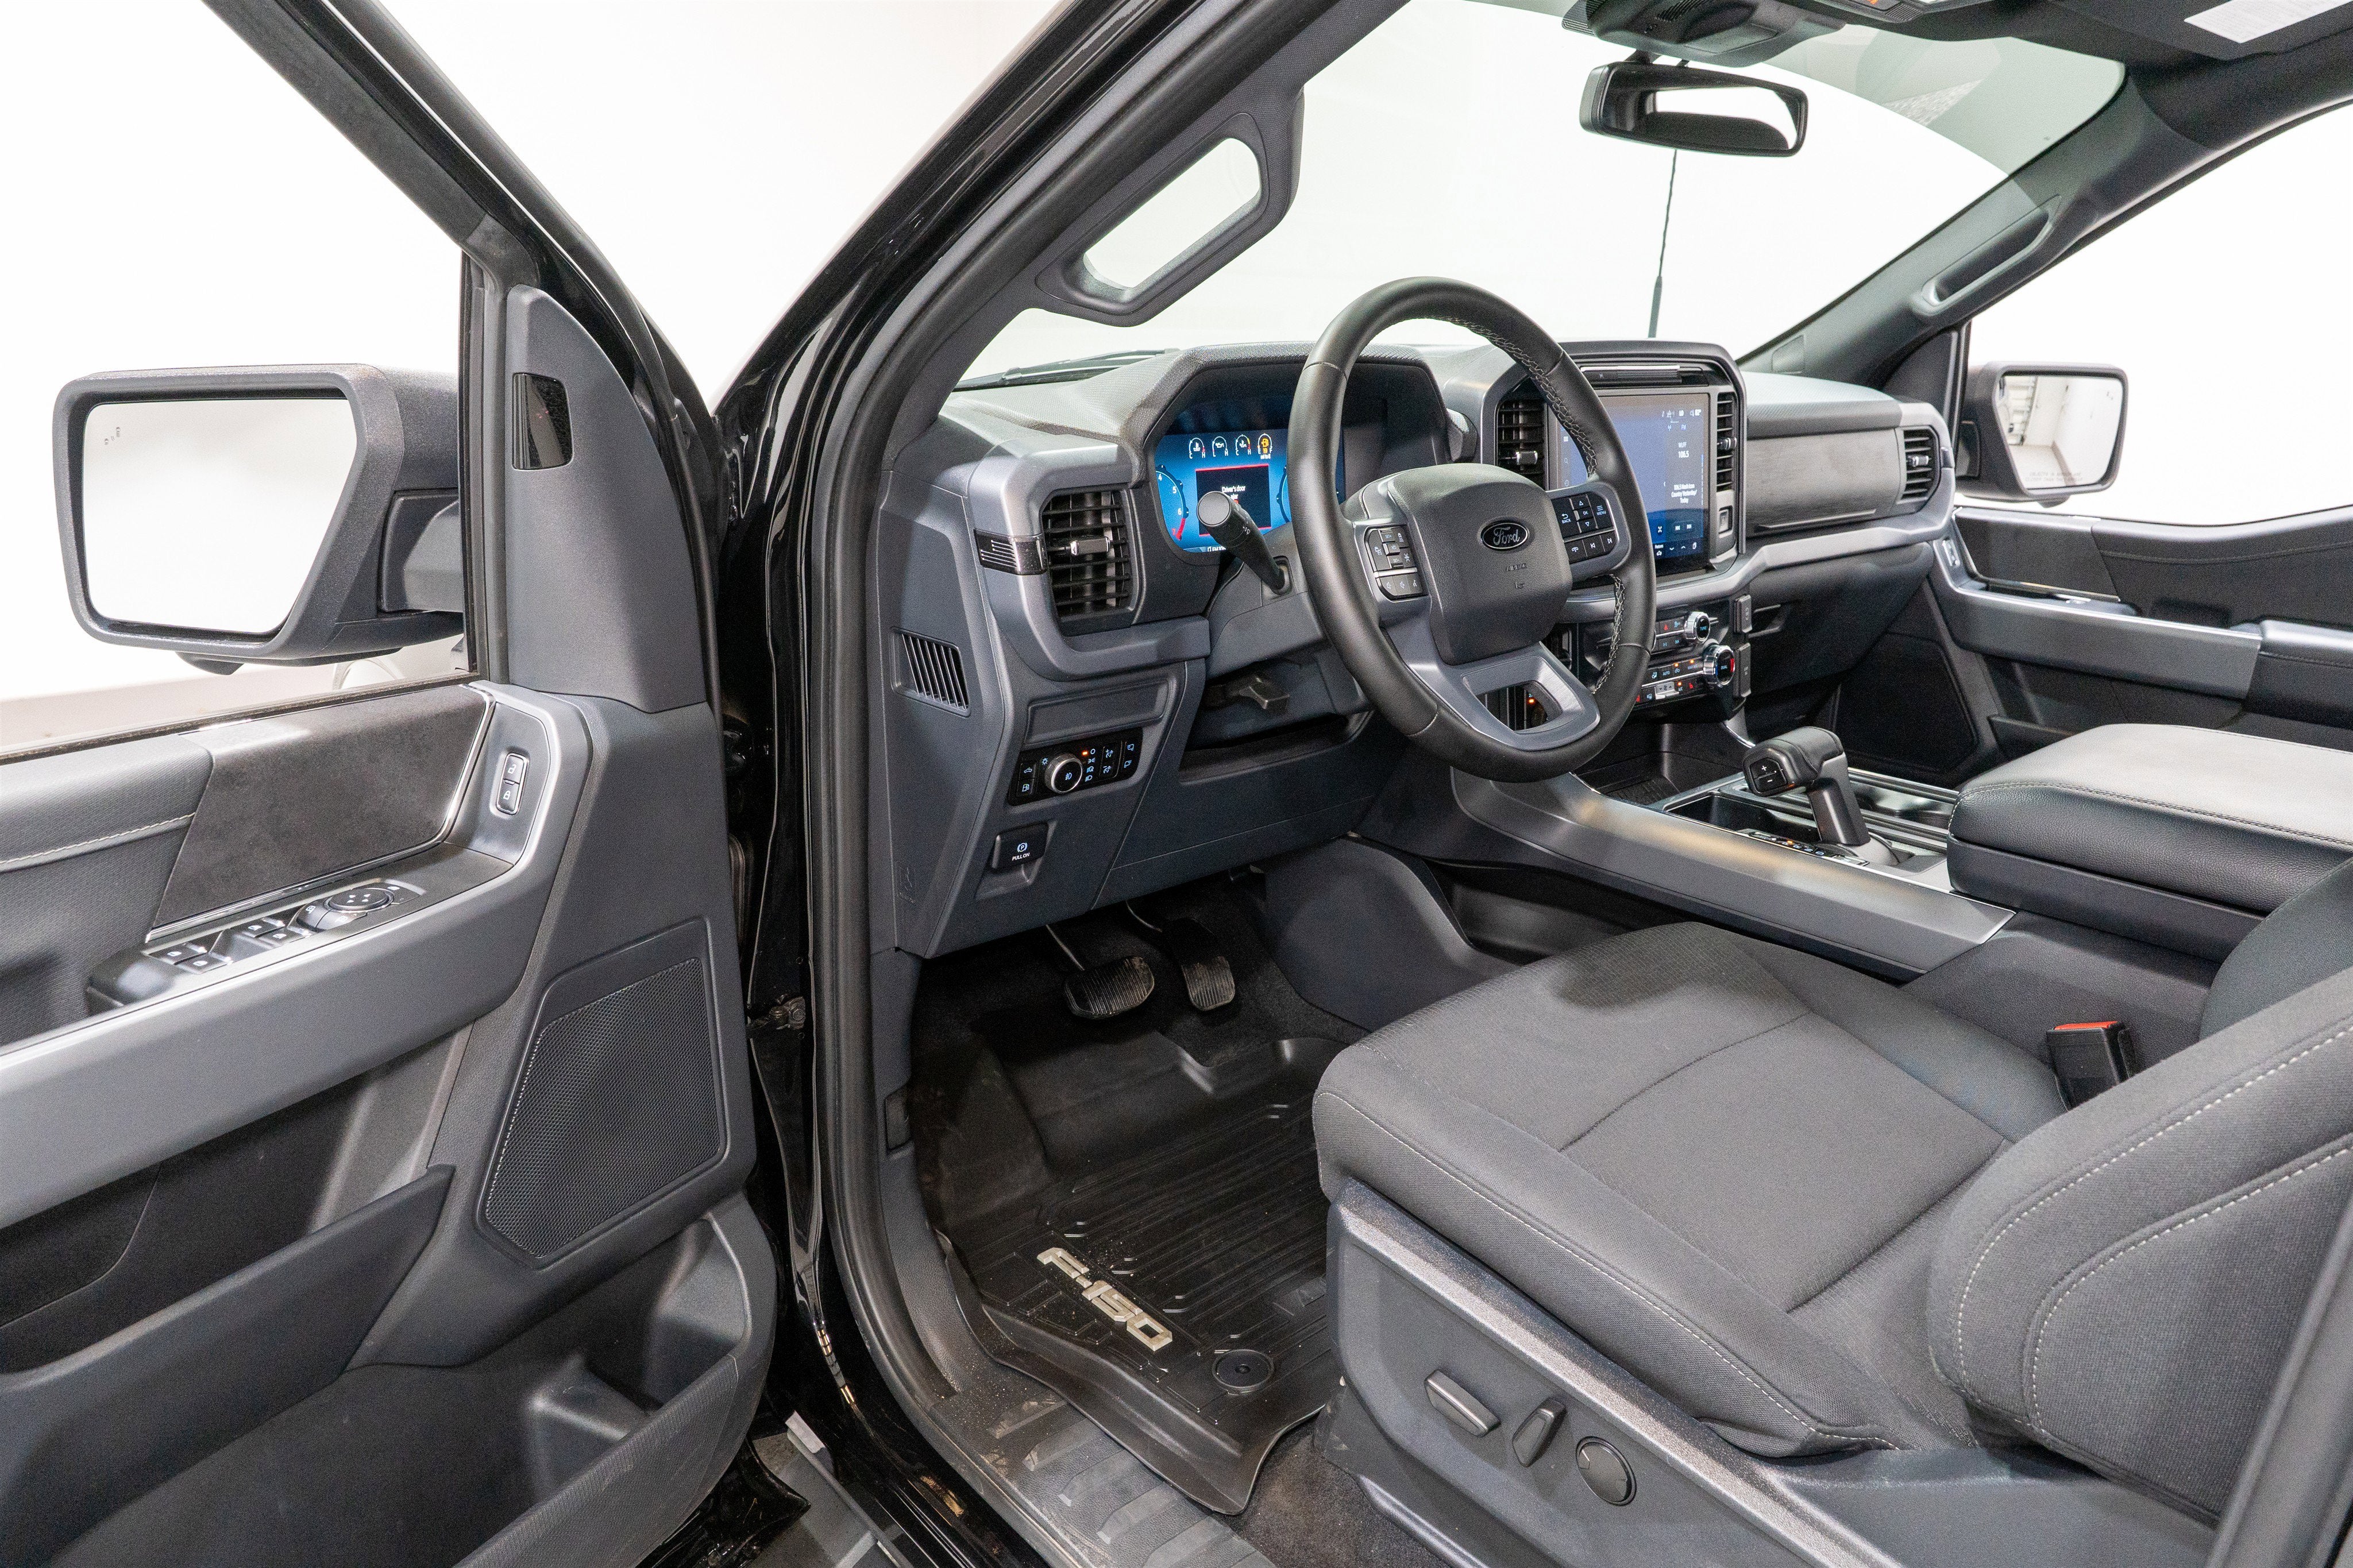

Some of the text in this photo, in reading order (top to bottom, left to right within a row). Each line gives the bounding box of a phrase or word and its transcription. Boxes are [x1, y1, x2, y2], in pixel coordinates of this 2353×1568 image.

[1172, 486, 1176, 494] 5
[1493, 526, 1520, 545] Ford
[1037, 1247, 1173, 1351] F-150
